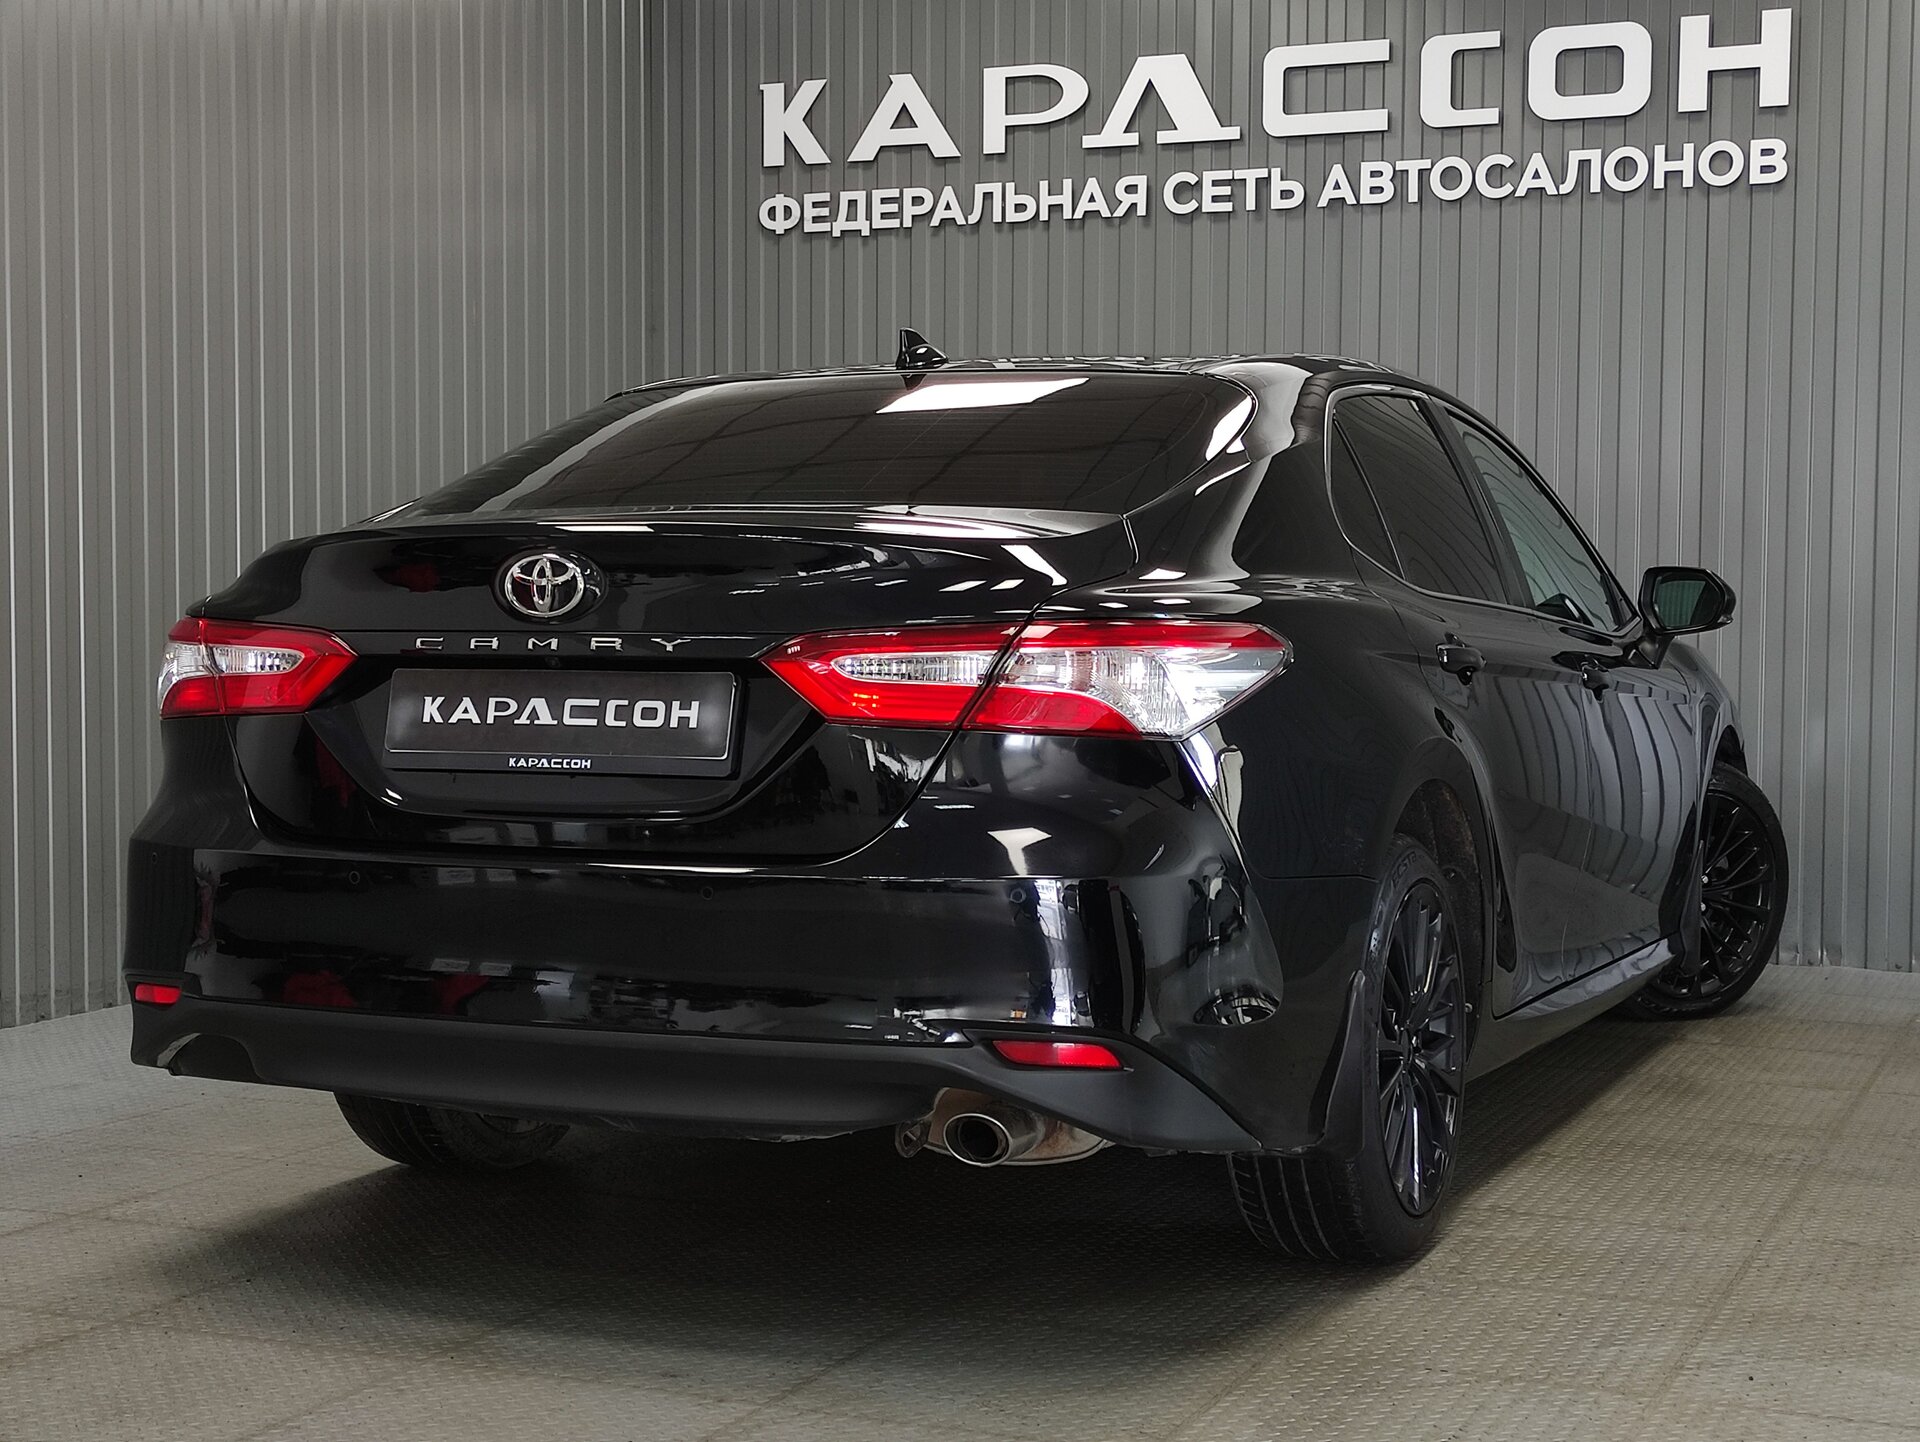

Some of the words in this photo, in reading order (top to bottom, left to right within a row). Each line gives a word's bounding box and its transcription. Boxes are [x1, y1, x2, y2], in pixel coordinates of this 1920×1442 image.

[759, 7, 1792, 168] КАРАССОН
[759, 174, 1148, 237] ФЕДЕРАЛЬНАЯ
[1163, 167, 1305, 214] СЕТЬ
[1317, 138, 1789, 208] АВТОСАЛОНОВ
[415, 635, 692, 652] CAMRY
